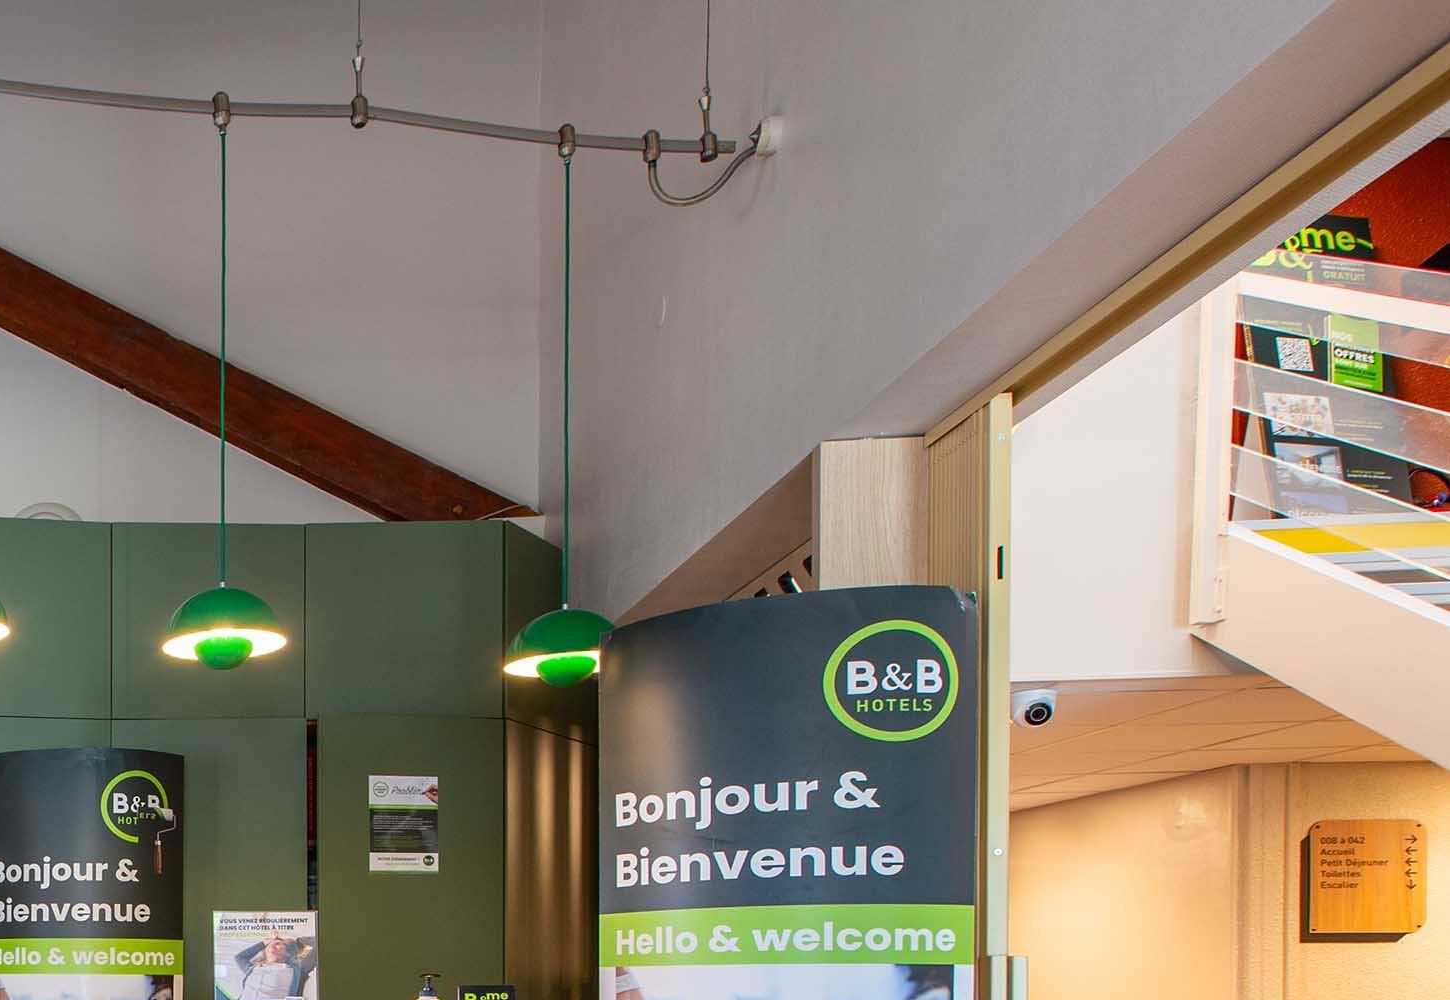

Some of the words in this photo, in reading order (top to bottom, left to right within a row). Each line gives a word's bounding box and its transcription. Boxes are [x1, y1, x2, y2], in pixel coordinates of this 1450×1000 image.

[1334, 348, 1375, 364] OFFRES
[846, 659, 943, 695] B&B
[855, 698, 933, 713] HOTELS
[614, 776, 820, 831] Bonjour
[833, 771, 881, 809] &
[1348, 836, 1366, 844] 042
[1320, 848, 1355, 856] Accueil
[115, 858, 140, 882] &
[615, 843, 906, 888] Bienvenue
[1320, 859, 1343, 867] Petit
[1346, 858, 1389, 868] Déjeuner
[1320, 870, 1362, 878] Toilettes
[1320, 881, 1359, 889] Escalier
[615, 926, 698, 956] Hello
[708, 925, 742, 953] &
[752, 921, 956, 953] welcome
[47, 948, 66, 966] &
[74, 947, 175, 966] welcome
